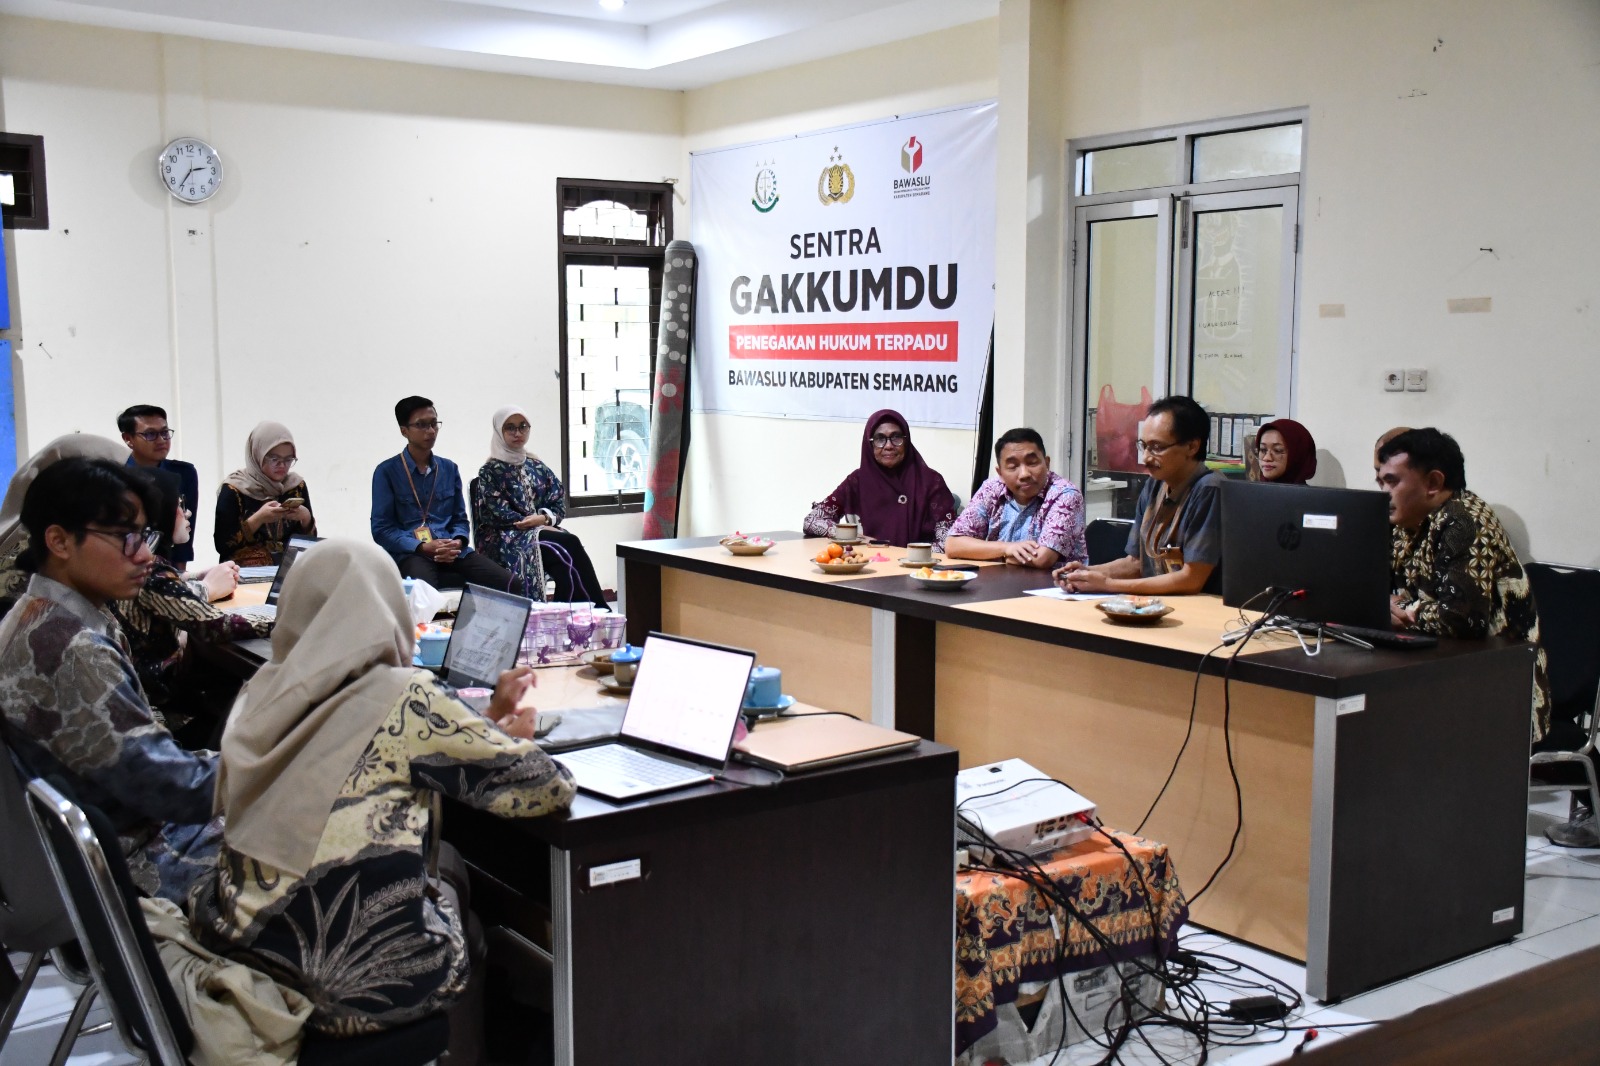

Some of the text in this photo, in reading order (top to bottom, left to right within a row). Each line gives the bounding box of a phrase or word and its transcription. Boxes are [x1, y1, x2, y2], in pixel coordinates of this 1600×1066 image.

[176, 147, 183, 155] 11
[185, 144, 194, 153] 12
[198, 148, 202, 156] 1
[169, 155, 177, 163] 10
[206, 156, 212, 164] 2
[210, 167, 216, 175] 3
[170, 177, 176, 185] 8
[893, 175, 930, 189] BAWASLU
[180, 184, 185, 192] 7
[189, 187, 195, 195] 6
[200, 185, 206, 193] 5
[790, 226, 881, 259] SENTRA
[730, 263, 958, 315] GAKKUMDU
[736, 333, 948, 351] PENEGAKAN HUKUM TERPADU
[729, 370, 958, 394] BAWASLU KABUPATEN SEMARANG
